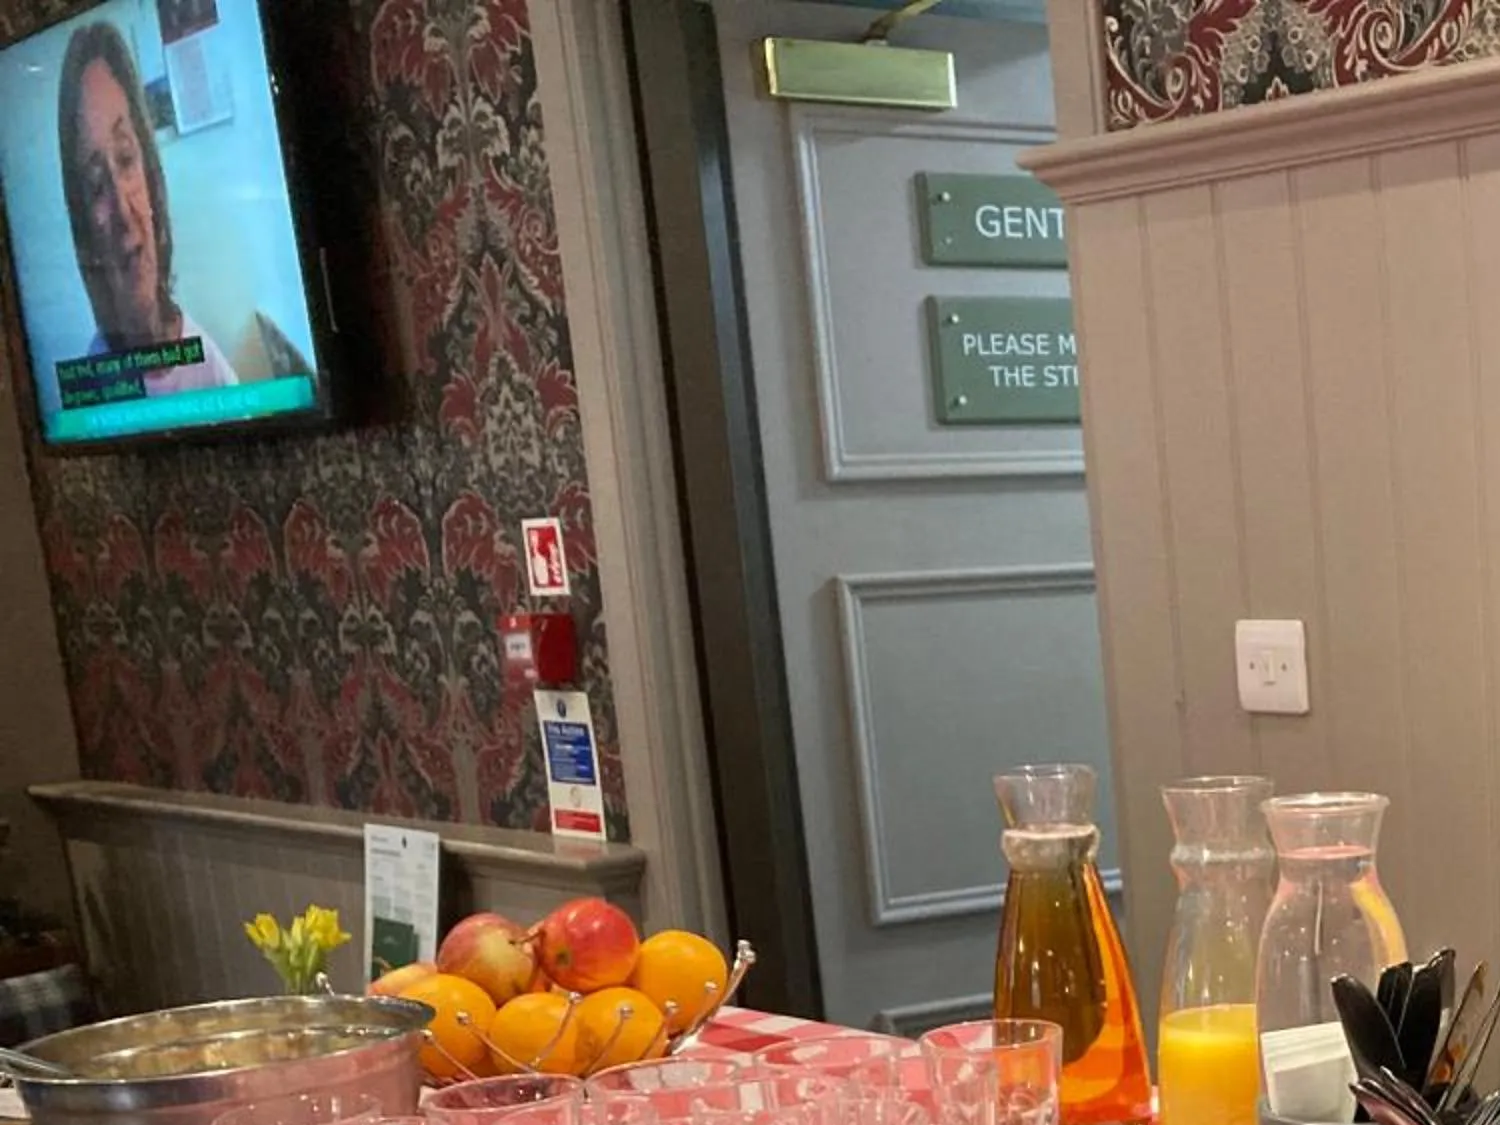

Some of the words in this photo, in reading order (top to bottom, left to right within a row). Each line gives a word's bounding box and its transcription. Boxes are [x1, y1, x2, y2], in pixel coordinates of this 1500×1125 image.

[975, 205, 1065, 239] GENT
[963, 333, 1050, 356] PLEASE
[989, 365, 1038, 387] THE
[1044, 365, 1079, 387] ST
